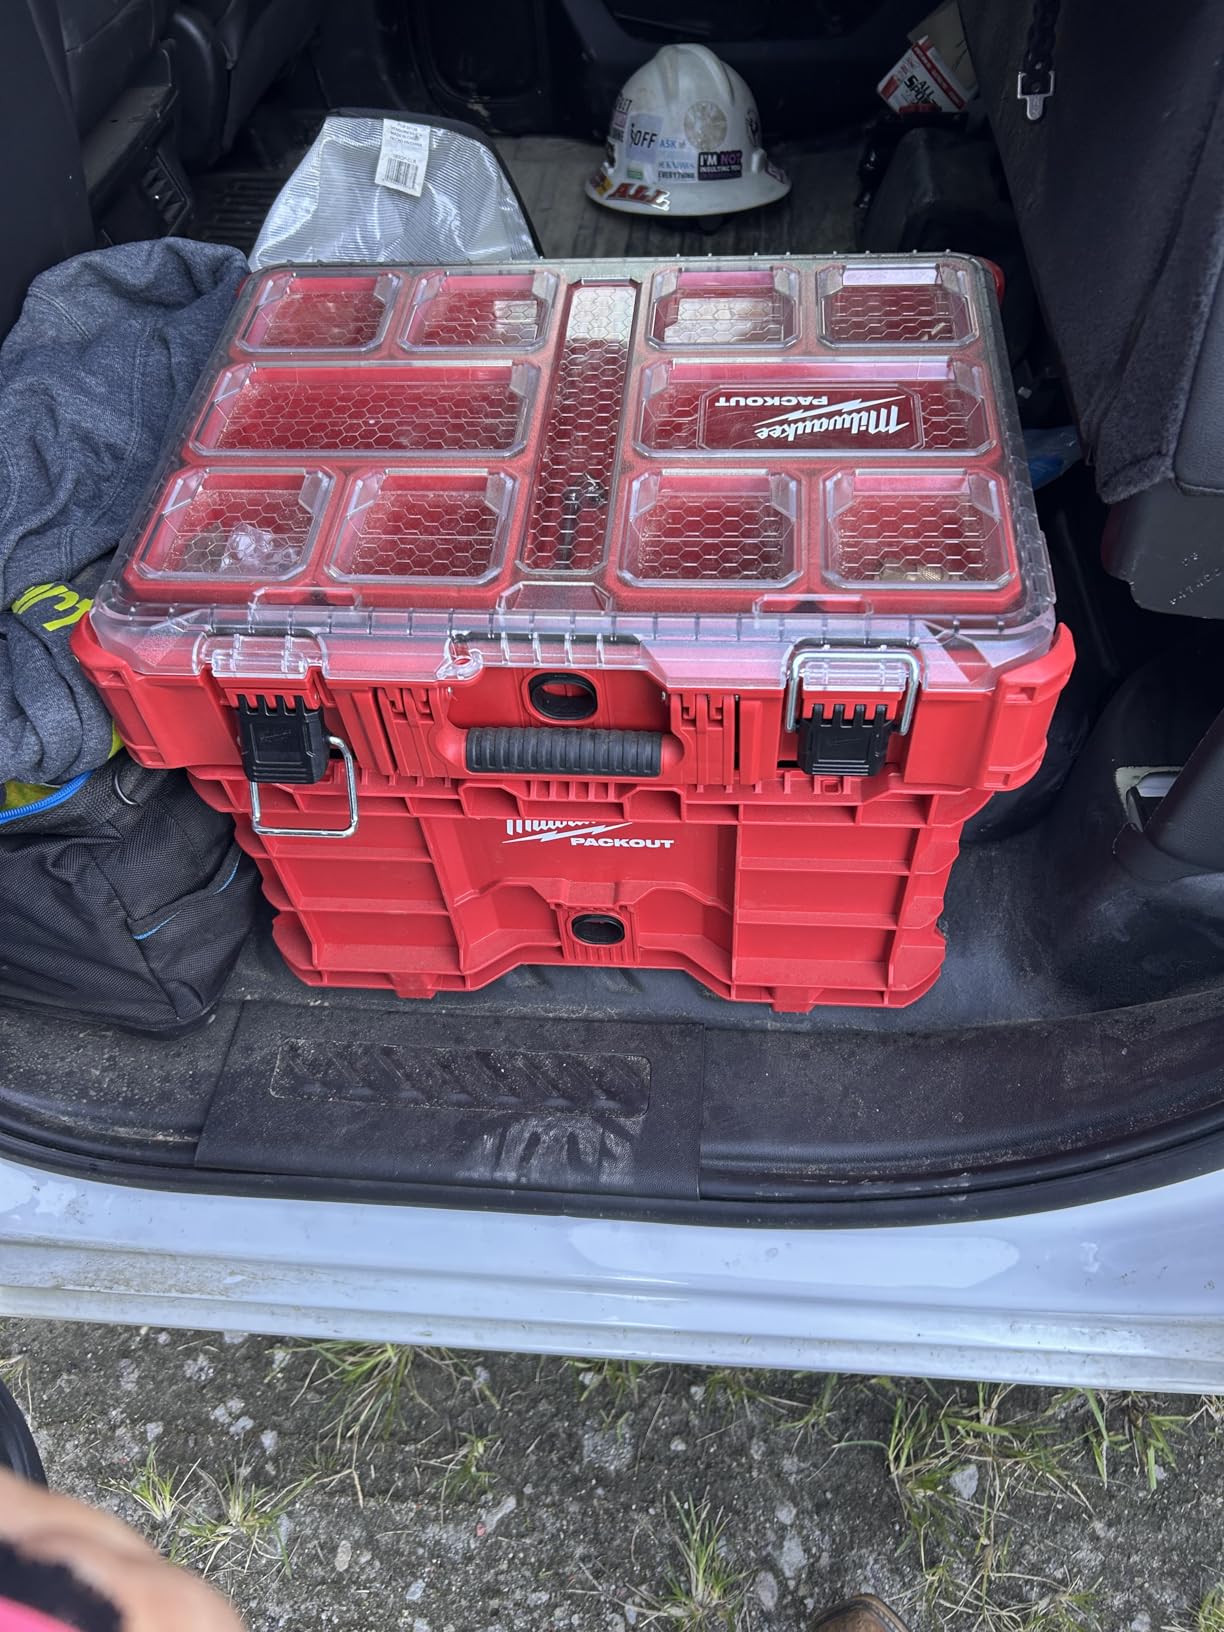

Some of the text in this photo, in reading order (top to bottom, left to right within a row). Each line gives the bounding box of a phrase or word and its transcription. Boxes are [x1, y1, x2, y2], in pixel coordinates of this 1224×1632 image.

[700, 152, 742, 166] I'M NOT
[714, 396, 829, 407] PACKOUT
[754, 404, 910, 442] Milwaukee
[570, 837, 675, 849] PACKOUT
